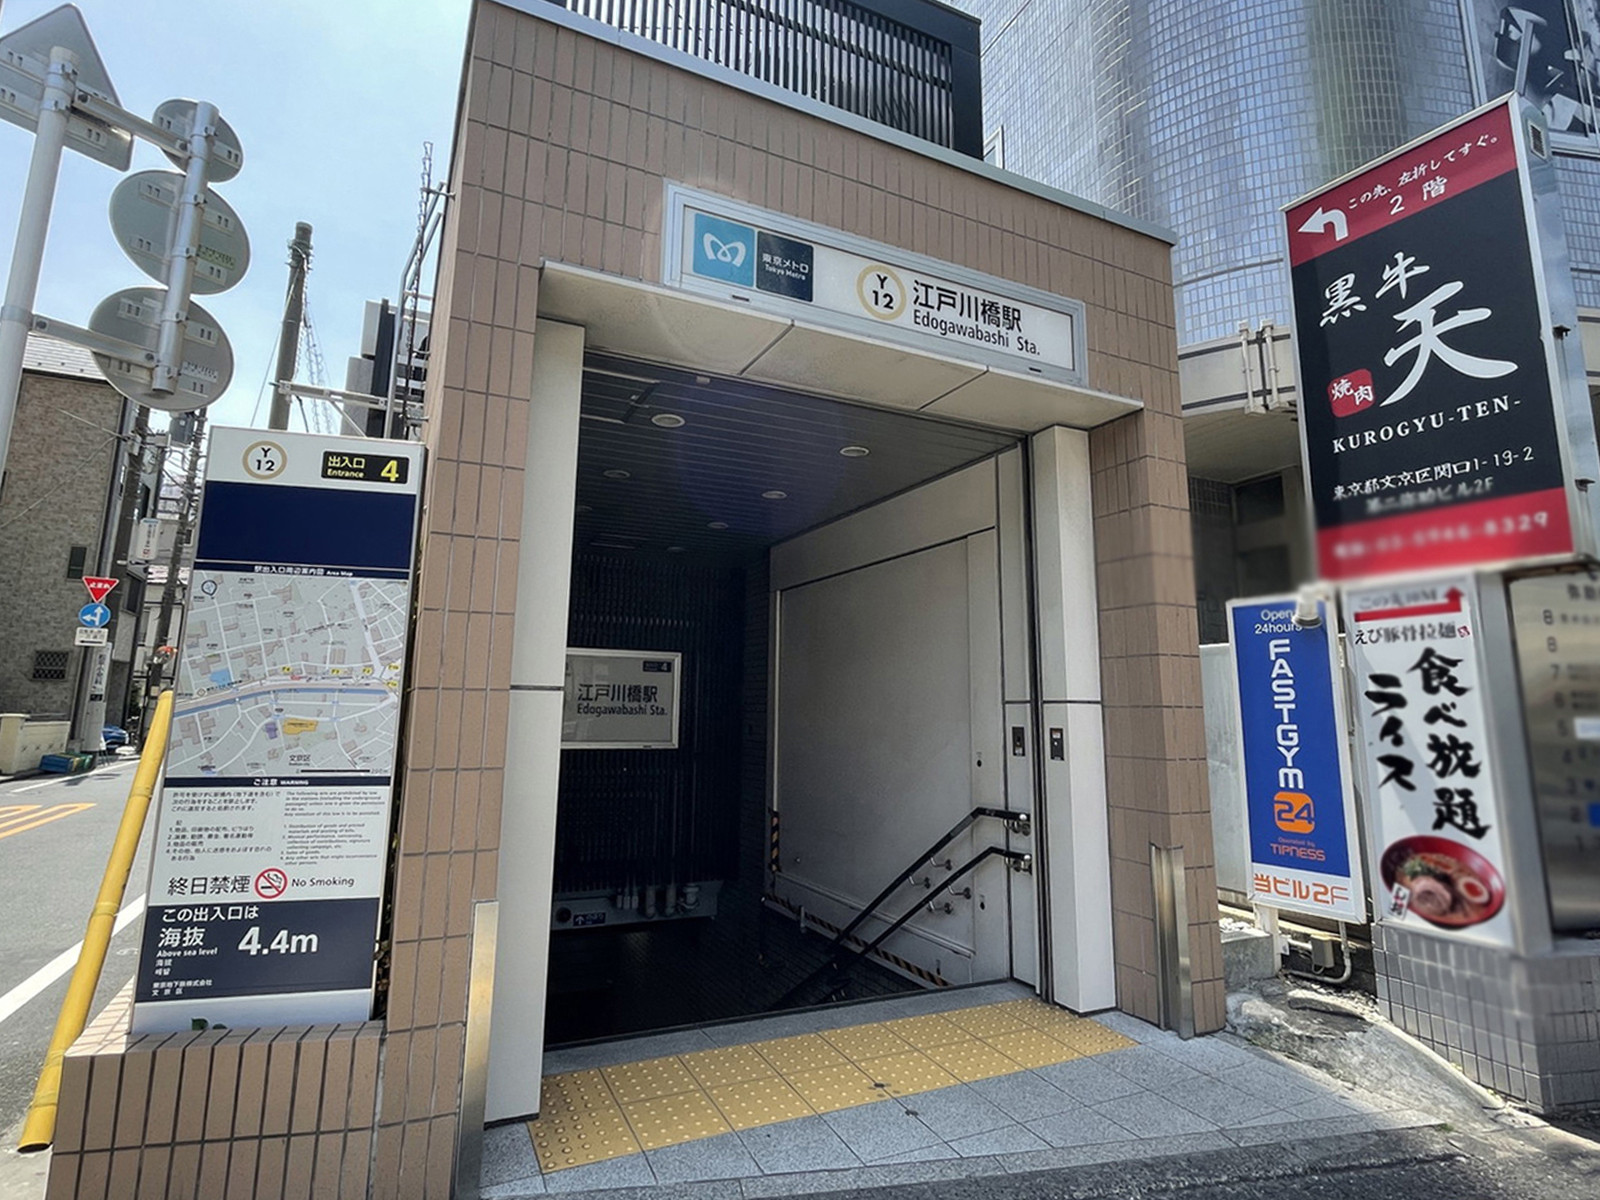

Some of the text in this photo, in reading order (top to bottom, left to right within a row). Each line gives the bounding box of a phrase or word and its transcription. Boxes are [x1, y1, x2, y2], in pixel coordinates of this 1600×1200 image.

[1348, 133, 1499, 209] この先、左折してすぐ。
[762, 252, 809, 274] 東京メトロ
[764, 263, 806, 281] Tokyo Metro
[875, 274, 888, 289] Y
[1319, 251, 1431, 327] 黒牛
[872, 289, 894, 311] 12
[913, 279, 1022, 333] 江戸川橋駅
[913, 309, 1041, 357] Edogawabashi Sta.
[1379, 280, 1519, 408] 天
[1331, 378, 1375, 406] 焼肉
[261, 447, 272, 458] Y
[327, 455, 366, 469] 出入口
[255, 459, 276, 472] 12
[327, 459, 399, 482] Entrance 4
[1260, 609, 1294, 622] Open
[1254, 621, 1303, 635] 24hours
[577, 683, 658, 703] 江戸川橋駅
[577, 703, 668, 717] Edogawabashi Sta.
[1363, 672, 1417, 793] ライス
[1406, 646, 1492, 841] 食べ放題
[253, 778, 278, 786] ご注意
[1274, 800, 1315, 825] 24
[1270, 843, 1326, 862] TIPNESS
[167, 875, 251, 896] 終日禁煙
[291, 876, 355, 888] No Smoking
[1254, 873, 1349, 905] 当ビル2F
[162, 905, 259, 923] この出入口は
[157, 926, 319, 956] 海抜 4.4m
[156, 947, 218, 958] Above sea level
